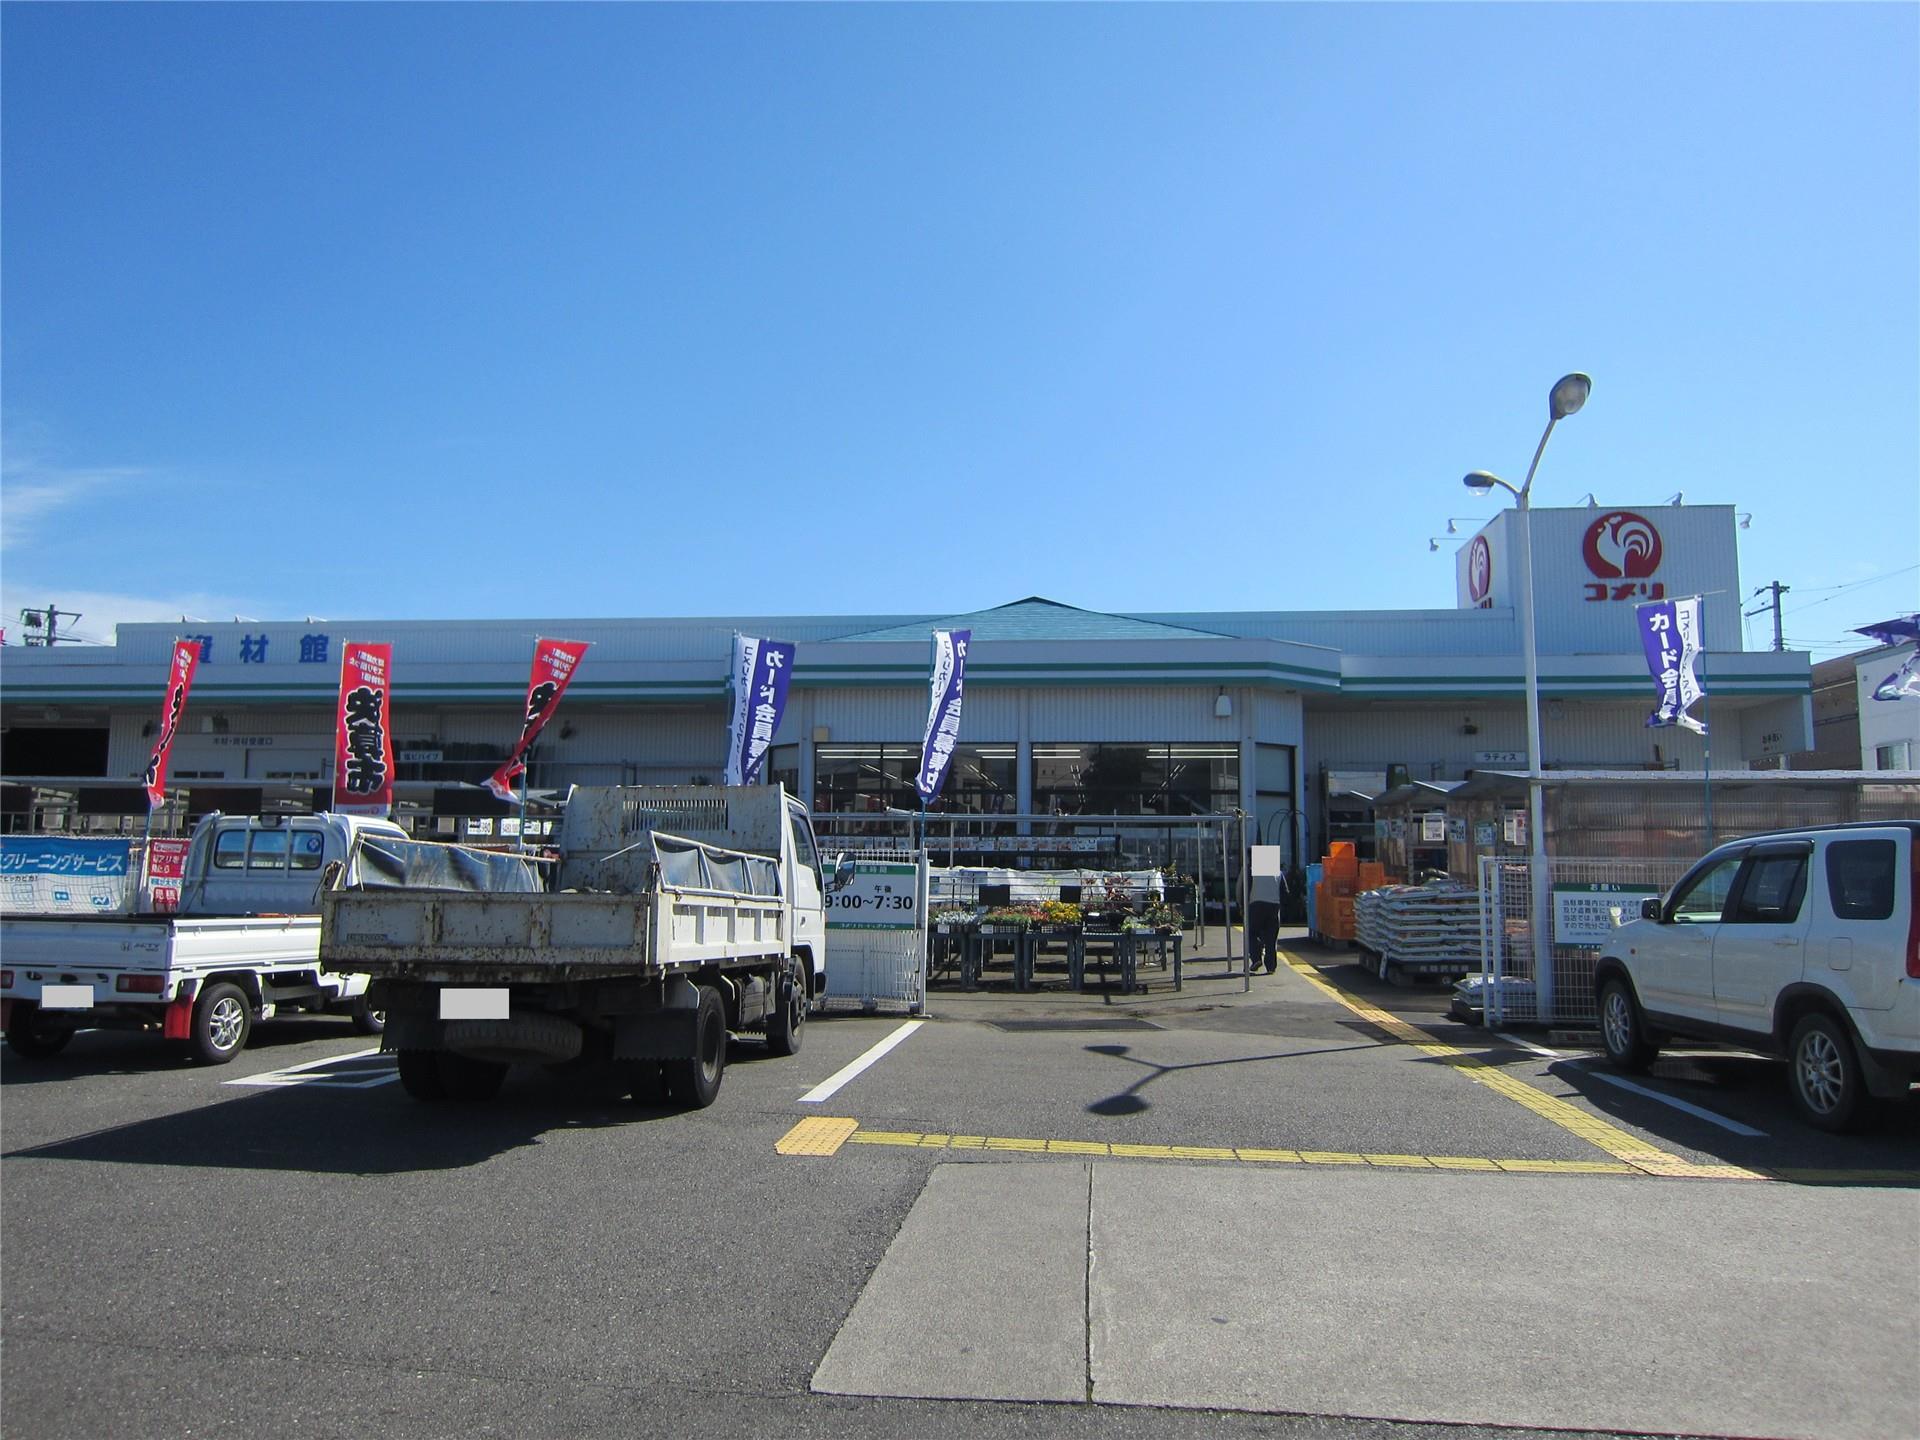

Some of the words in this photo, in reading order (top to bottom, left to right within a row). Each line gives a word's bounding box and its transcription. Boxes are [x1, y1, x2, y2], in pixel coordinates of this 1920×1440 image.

[1585, 583, 1664, 601] コメリ
[1483, 752, 1517, 761] ラティス
[0, 852, 123, 872] クリーニングサービス
